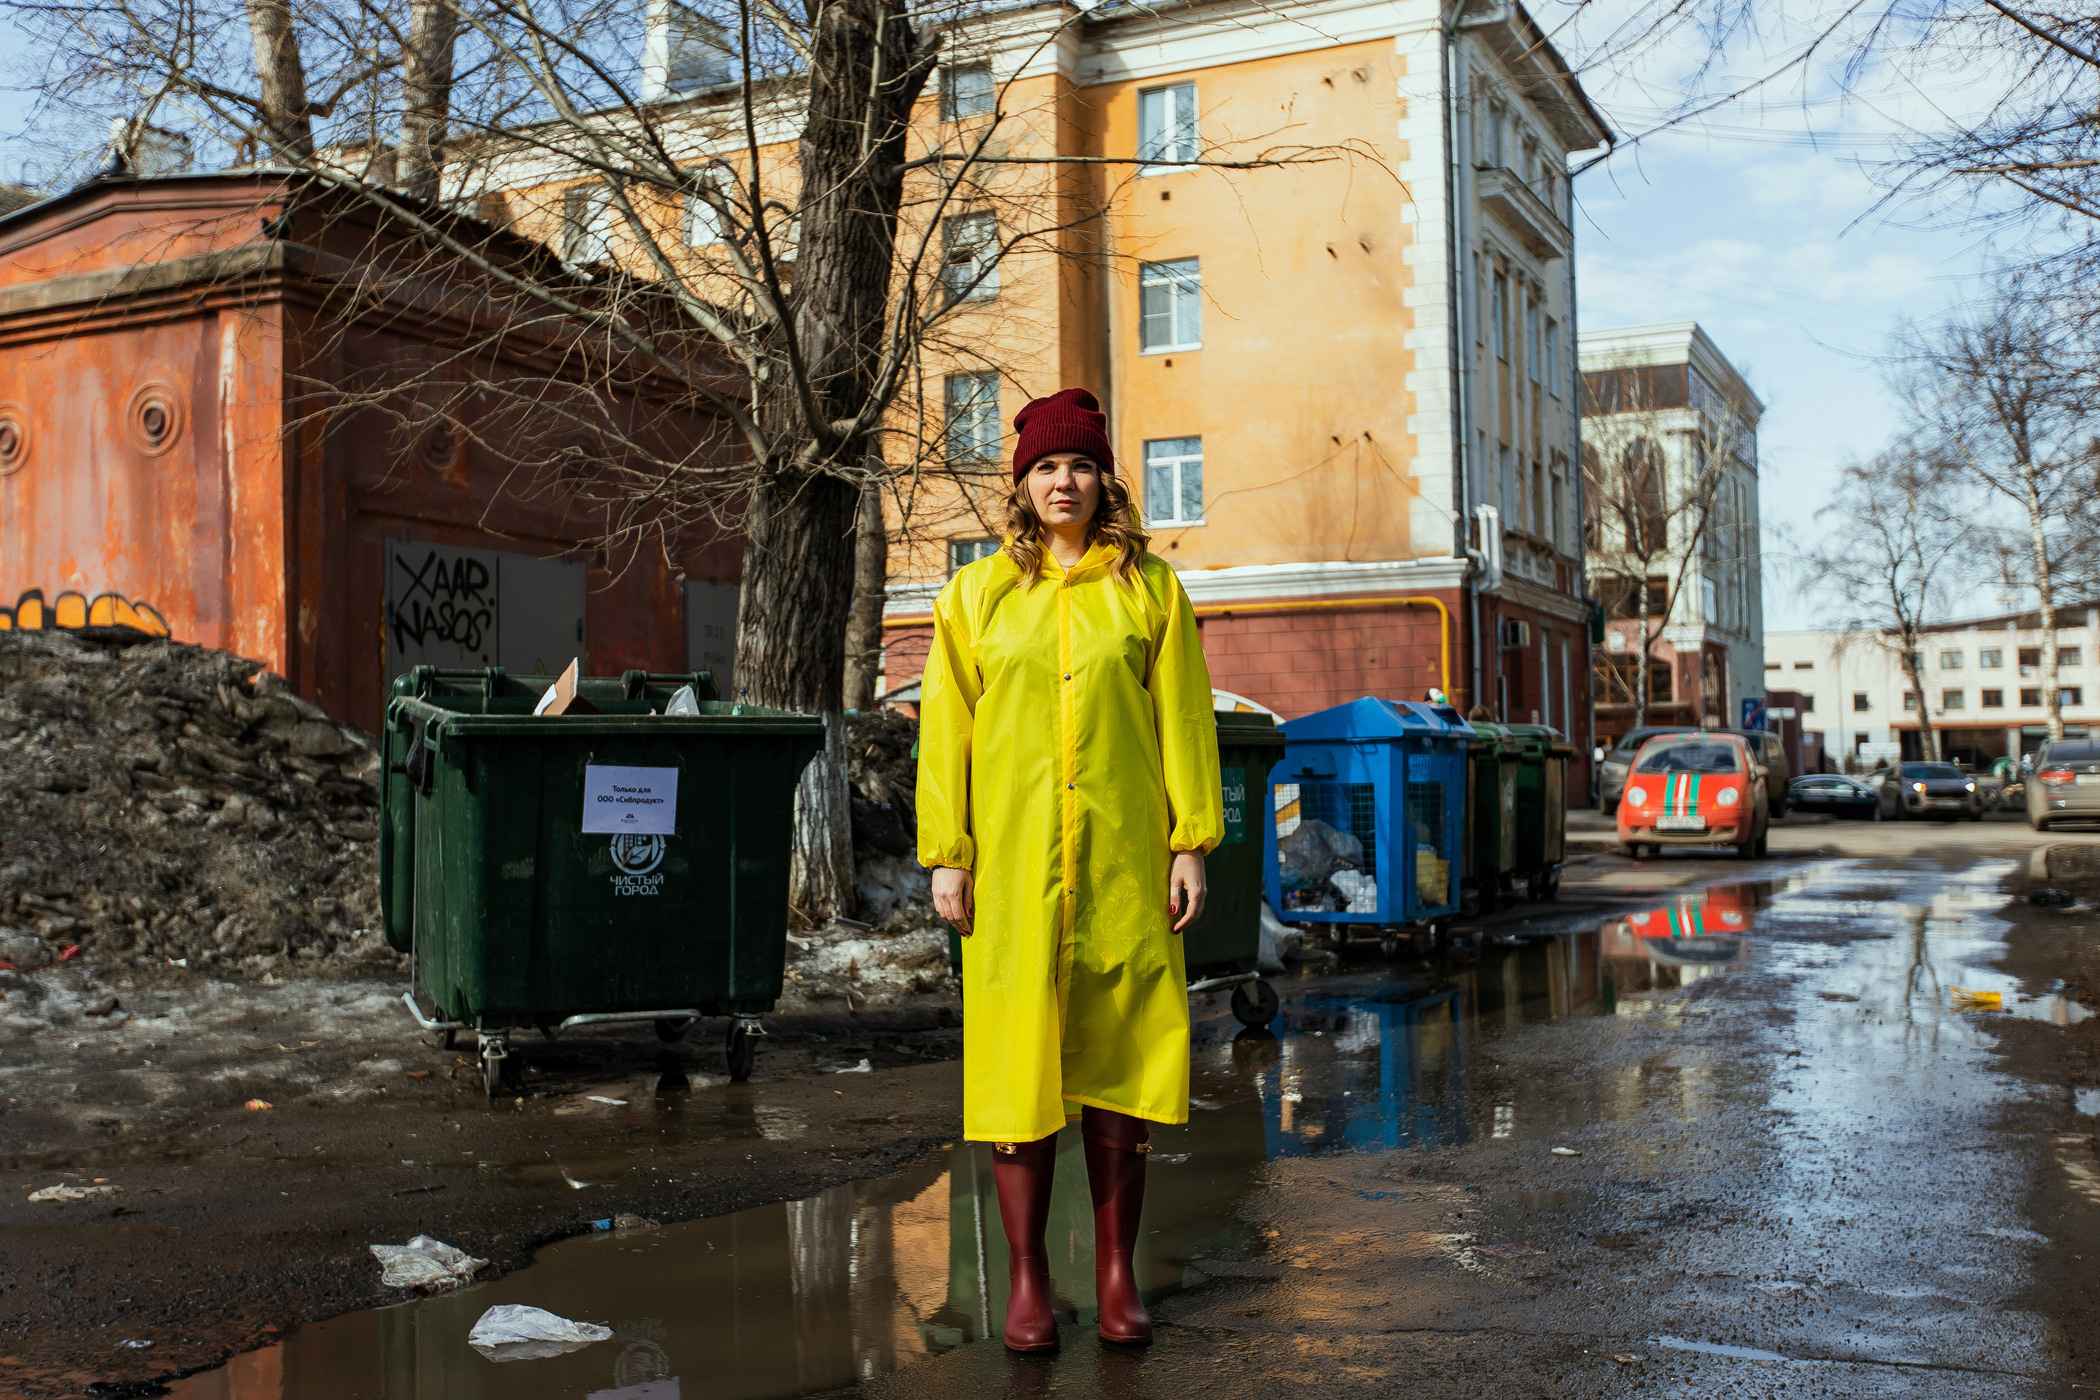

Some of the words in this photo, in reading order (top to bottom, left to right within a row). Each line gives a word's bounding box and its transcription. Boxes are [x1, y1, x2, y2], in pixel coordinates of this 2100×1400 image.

[612, 785, 637, 793] Только
[1222, 783, 1245, 801] ТЫЙ
[597, 795, 614, 803] ООО
[615, 796, 664, 805] «Сибпродукт»
[1223, 807, 1242, 823] РОД
[609, 872, 664, 886] ЧИСТЫЙ
[615, 885, 659, 896] ГОРОД
